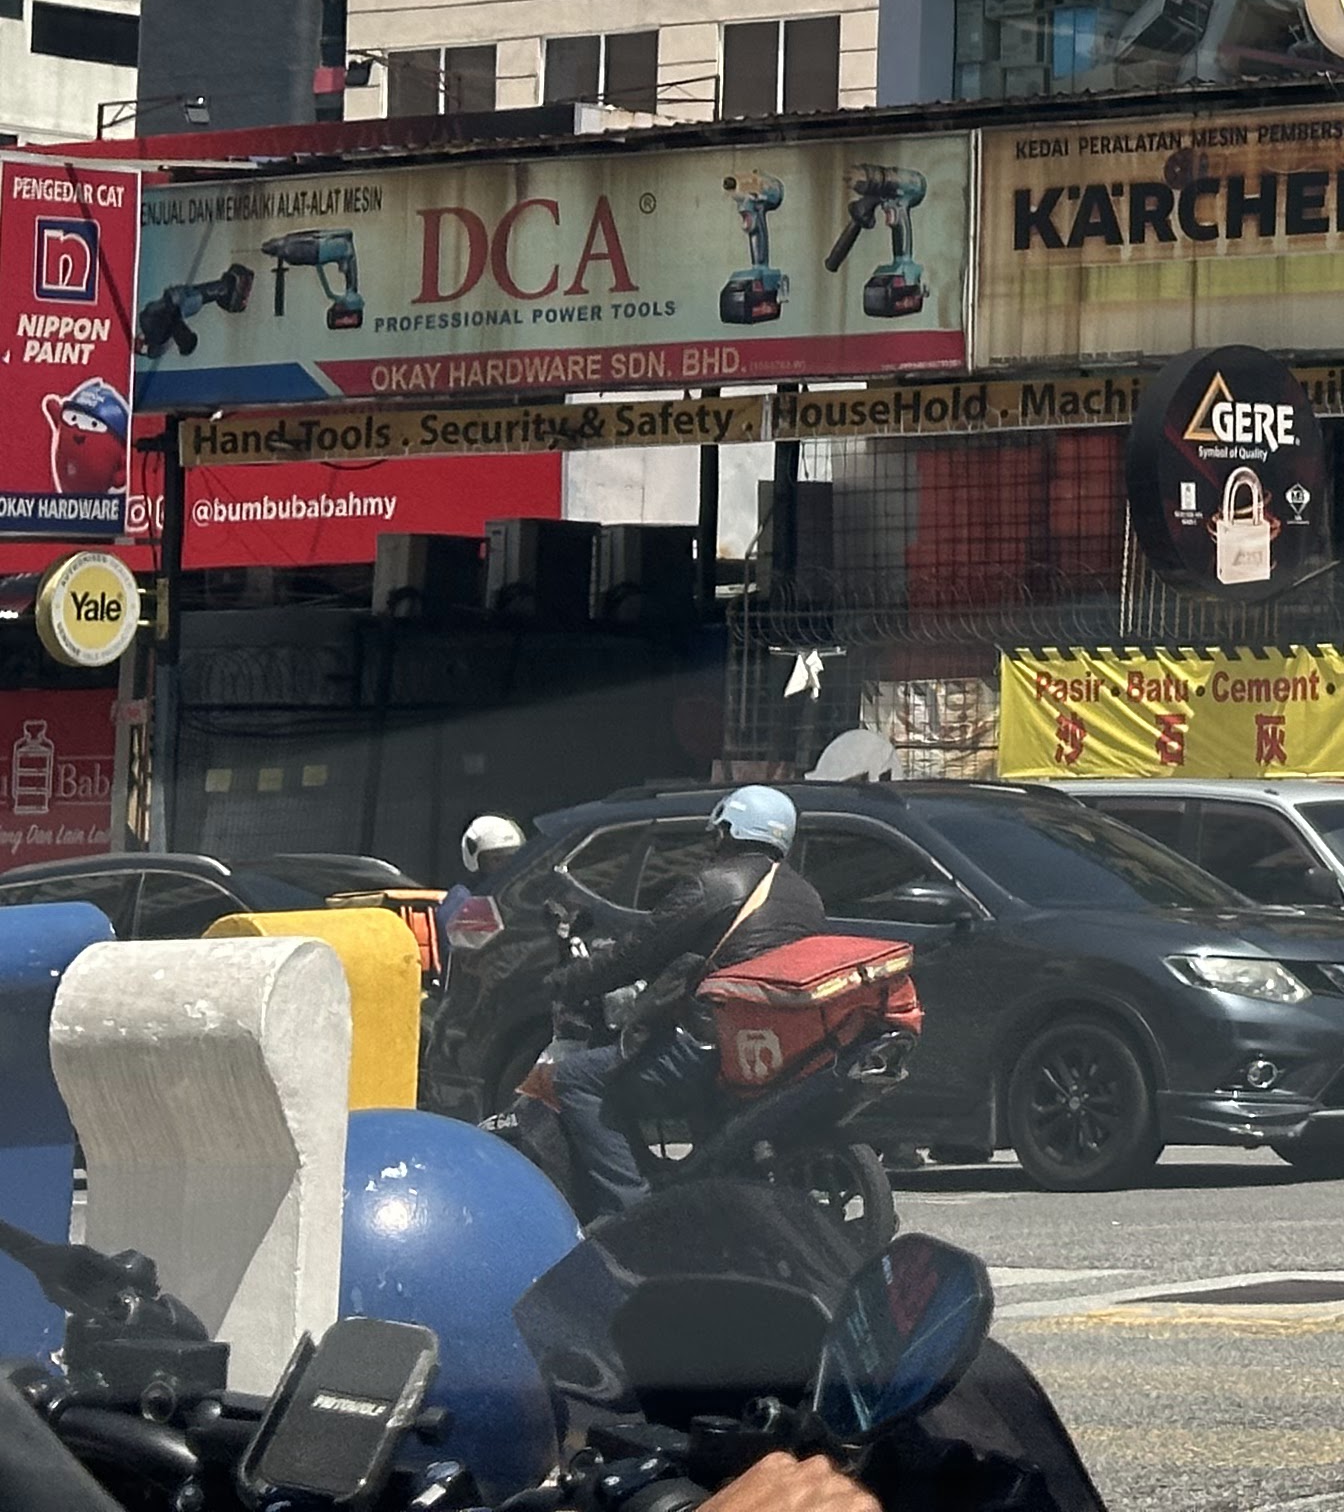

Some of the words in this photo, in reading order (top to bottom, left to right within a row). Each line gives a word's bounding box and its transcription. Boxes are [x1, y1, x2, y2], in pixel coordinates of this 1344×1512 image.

[1016, 137, 1070, 161] KEDAI
[1078, 130, 1183, 156] PERALATAN
[1191, 126, 1249, 150] MESIN
[13, 176, 93, 204] PENGEDAR
[97, 184, 125, 208] CAT
[141, 196, 186, 227] ENJUAL
[188, 197, 214, 225] DAN
[215, 192, 275, 224] MEMBAIKI
[276, 187, 341, 218] ALAT-ALAT
[342, 185, 383, 214] MESIN
[411, 194, 640, 305] DCA
[16, 313, 111, 341] NIPPON
[374, 304, 524, 333] PROFESSIONAL
[531, 302, 603, 325] POWER
[611, 299, 677, 319] TOOLS
[23, 340, 95, 365] PAINT
[371, 361, 442, 392] OKAY
[448, 352, 602, 388] HARDWARE
[611, 350, 672, 379] SDN.
[682, 345, 748, 376] BHD.
[193, 421, 286, 456] Hand
[298, 416, 392, 452] Tools
[420, 408, 571, 451] Security
[578, 408, 605, 440] &
[615, 403, 734, 441] Safety
[771, 384, 988, 429] HouseHold
[1020, 378, 1140, 419] Machi
[1211, 400, 1296, 454] GERE
[1198, 445, 1229, 461] Symbol
[1230, 446, 1239, 459] of
[1239, 446, 1269, 463] Quality
[38, 497, 119, 521] HARDWARE
[192, 491, 398, 527] @bumbubabahmy
[70, 591, 122, 622] Yale
[1036, 670, 1101, 703] Pasir
[1126, 670, 1189, 704] Batu
[1211, 669, 1320, 703] Cement
[1055, 711, 1087, 766] 沙
[1155, 713, 1188, 766] 石
[1255, 713, 1288, 766] 灰
